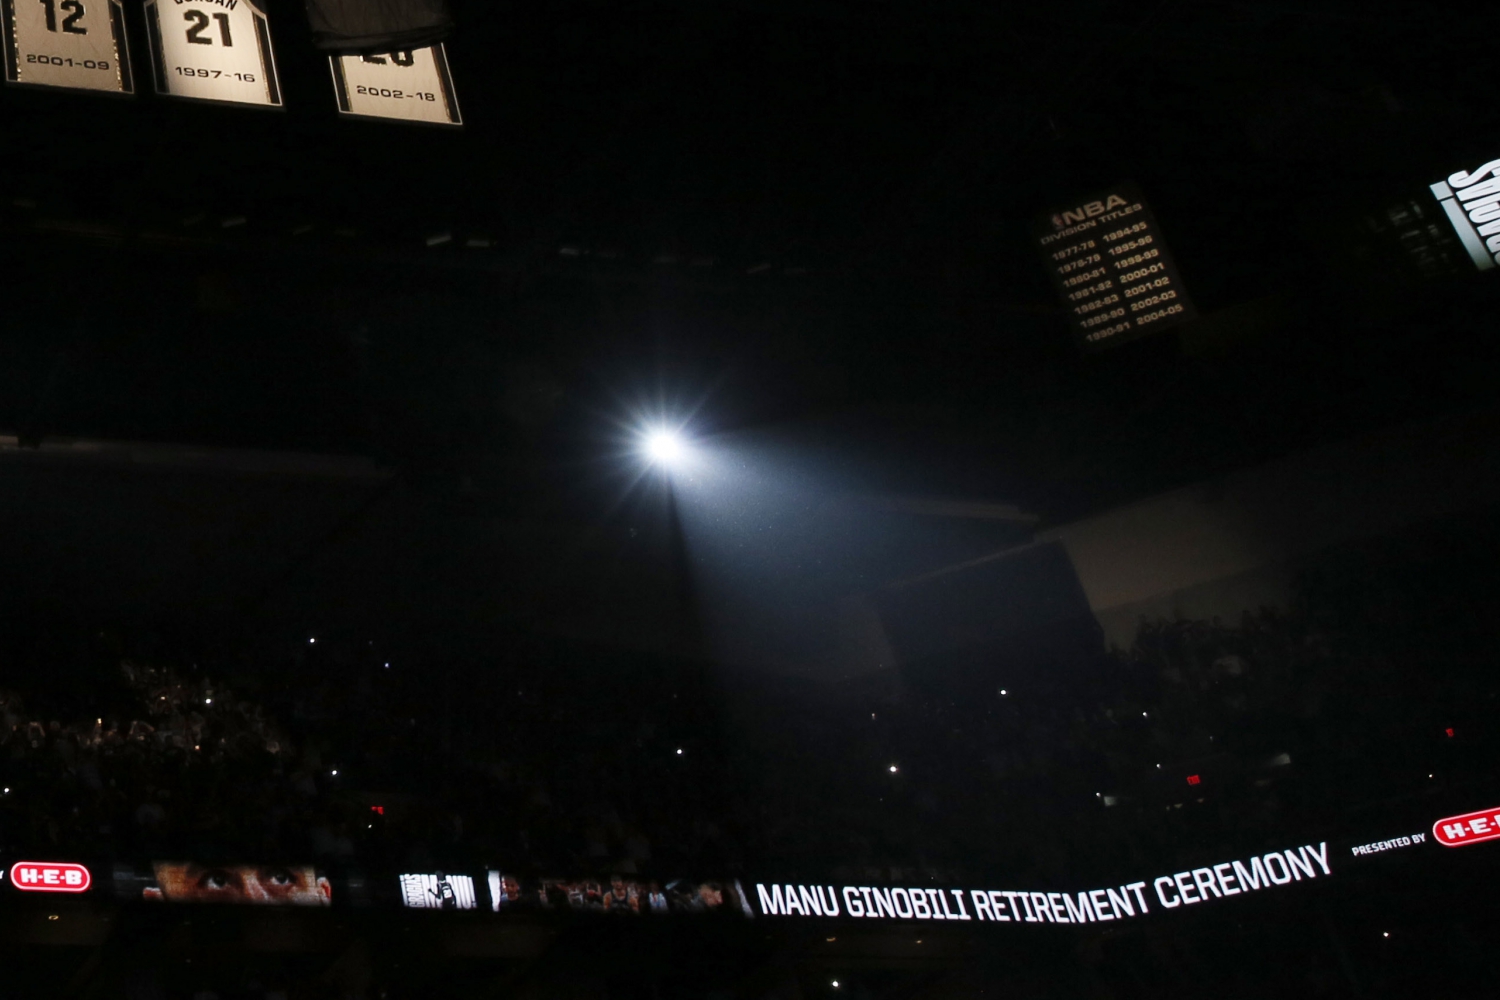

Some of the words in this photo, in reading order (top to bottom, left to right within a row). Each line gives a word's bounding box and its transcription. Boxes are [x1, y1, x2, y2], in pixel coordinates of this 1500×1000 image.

[183, 9, 234, 47] 21
[26, 53, 110, 71] 2001-09
[175, 66, 255, 83] 1997-16
[356, 85, 435, 102] 2002-18
[1061, 194, 1127, 226] NBA
[1040, 219, 1097, 245] DIVISION
[1099, 203, 1143, 224] TITLES
[1119, 262, 1165, 283] 2000-01
[1124, 276, 1170, 298] 2001-02
[1130, 290, 1176, 311] 2002-03
[1136, 304, 1184, 325] 2004-05
[1351, 836, 1411, 857] PRESENTED
[1412, 833, 1426, 844] BY
[20, 867, 83, 886] H-E-B
[756, 883, 840, 917] MANU
[842, 886, 972, 921] GINOBILI
[970, 881, 1150, 923] RETIREMENT
[1154, 841, 1331, 909] CEREMONY
